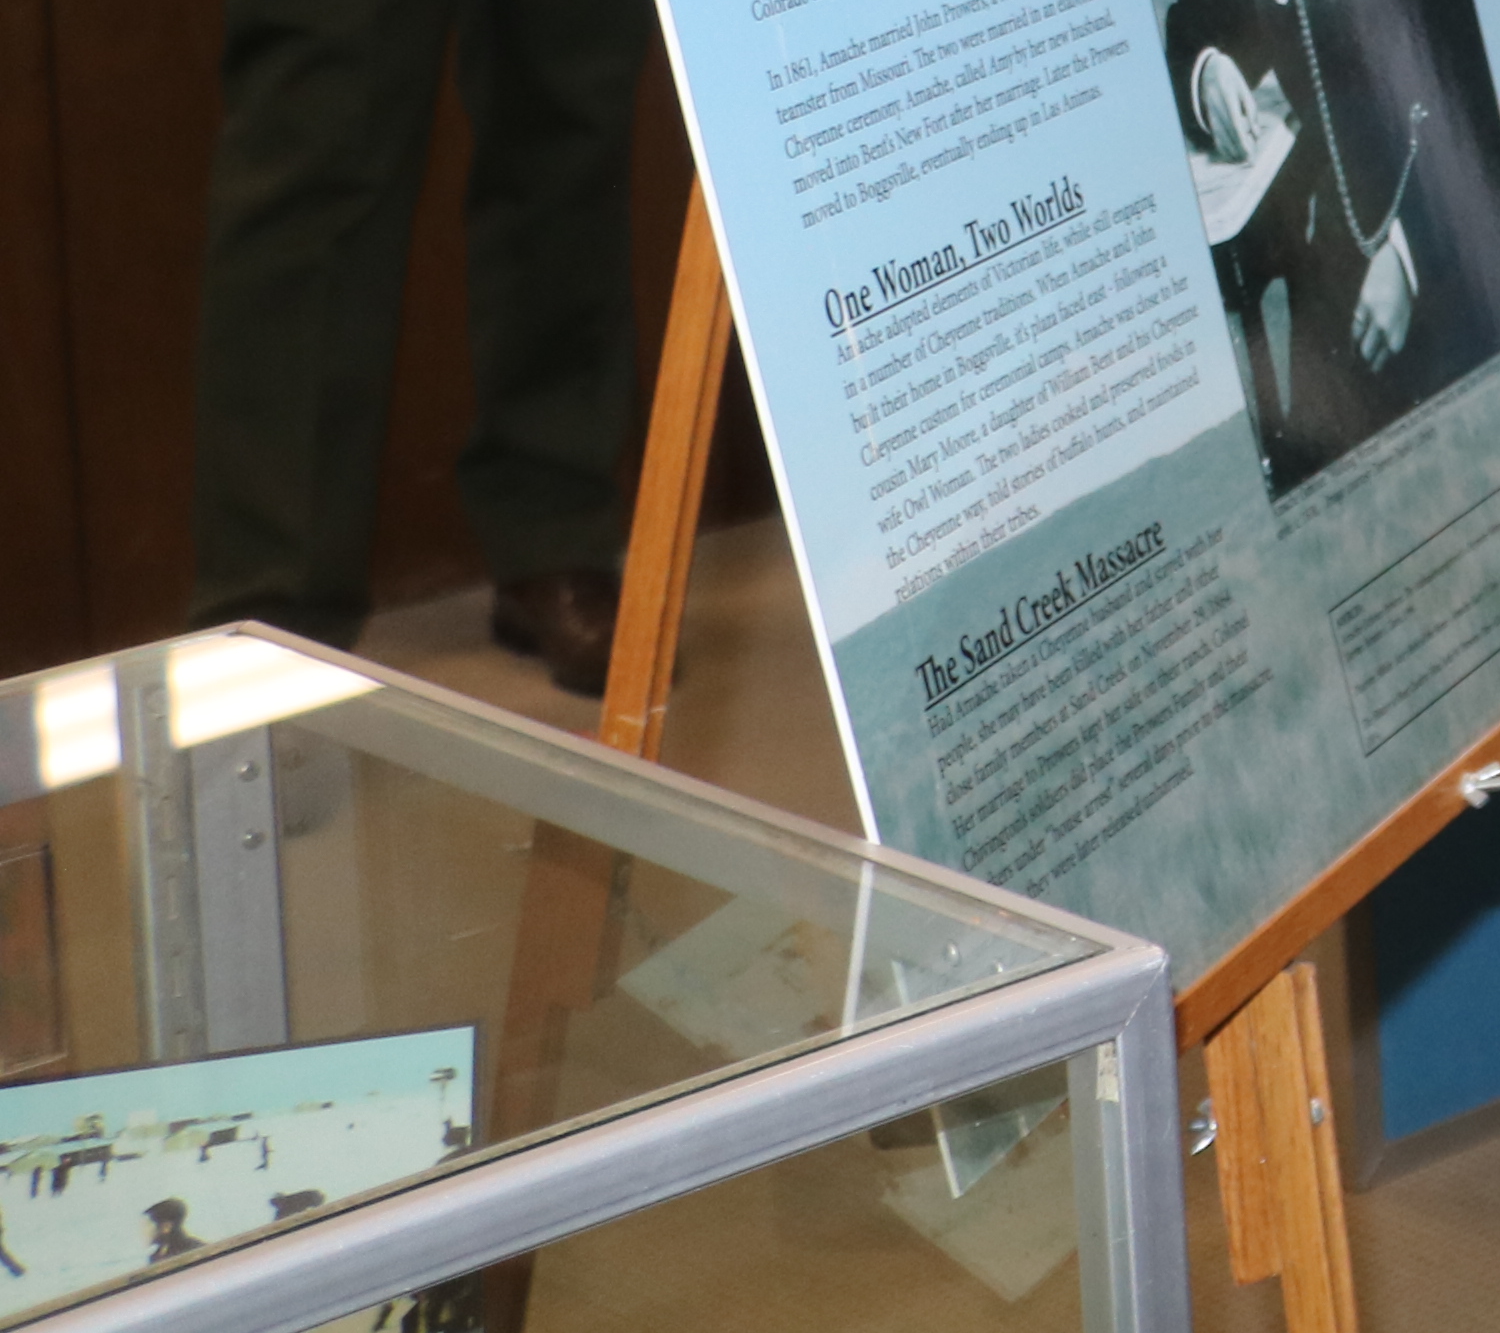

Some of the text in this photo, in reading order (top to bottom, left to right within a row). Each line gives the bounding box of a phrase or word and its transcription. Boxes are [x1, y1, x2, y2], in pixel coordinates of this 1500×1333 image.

[824, 175, 1084, 329] One Woman, Two Worlds
[914, 521, 1164, 702] The Sand Creek Massacre
